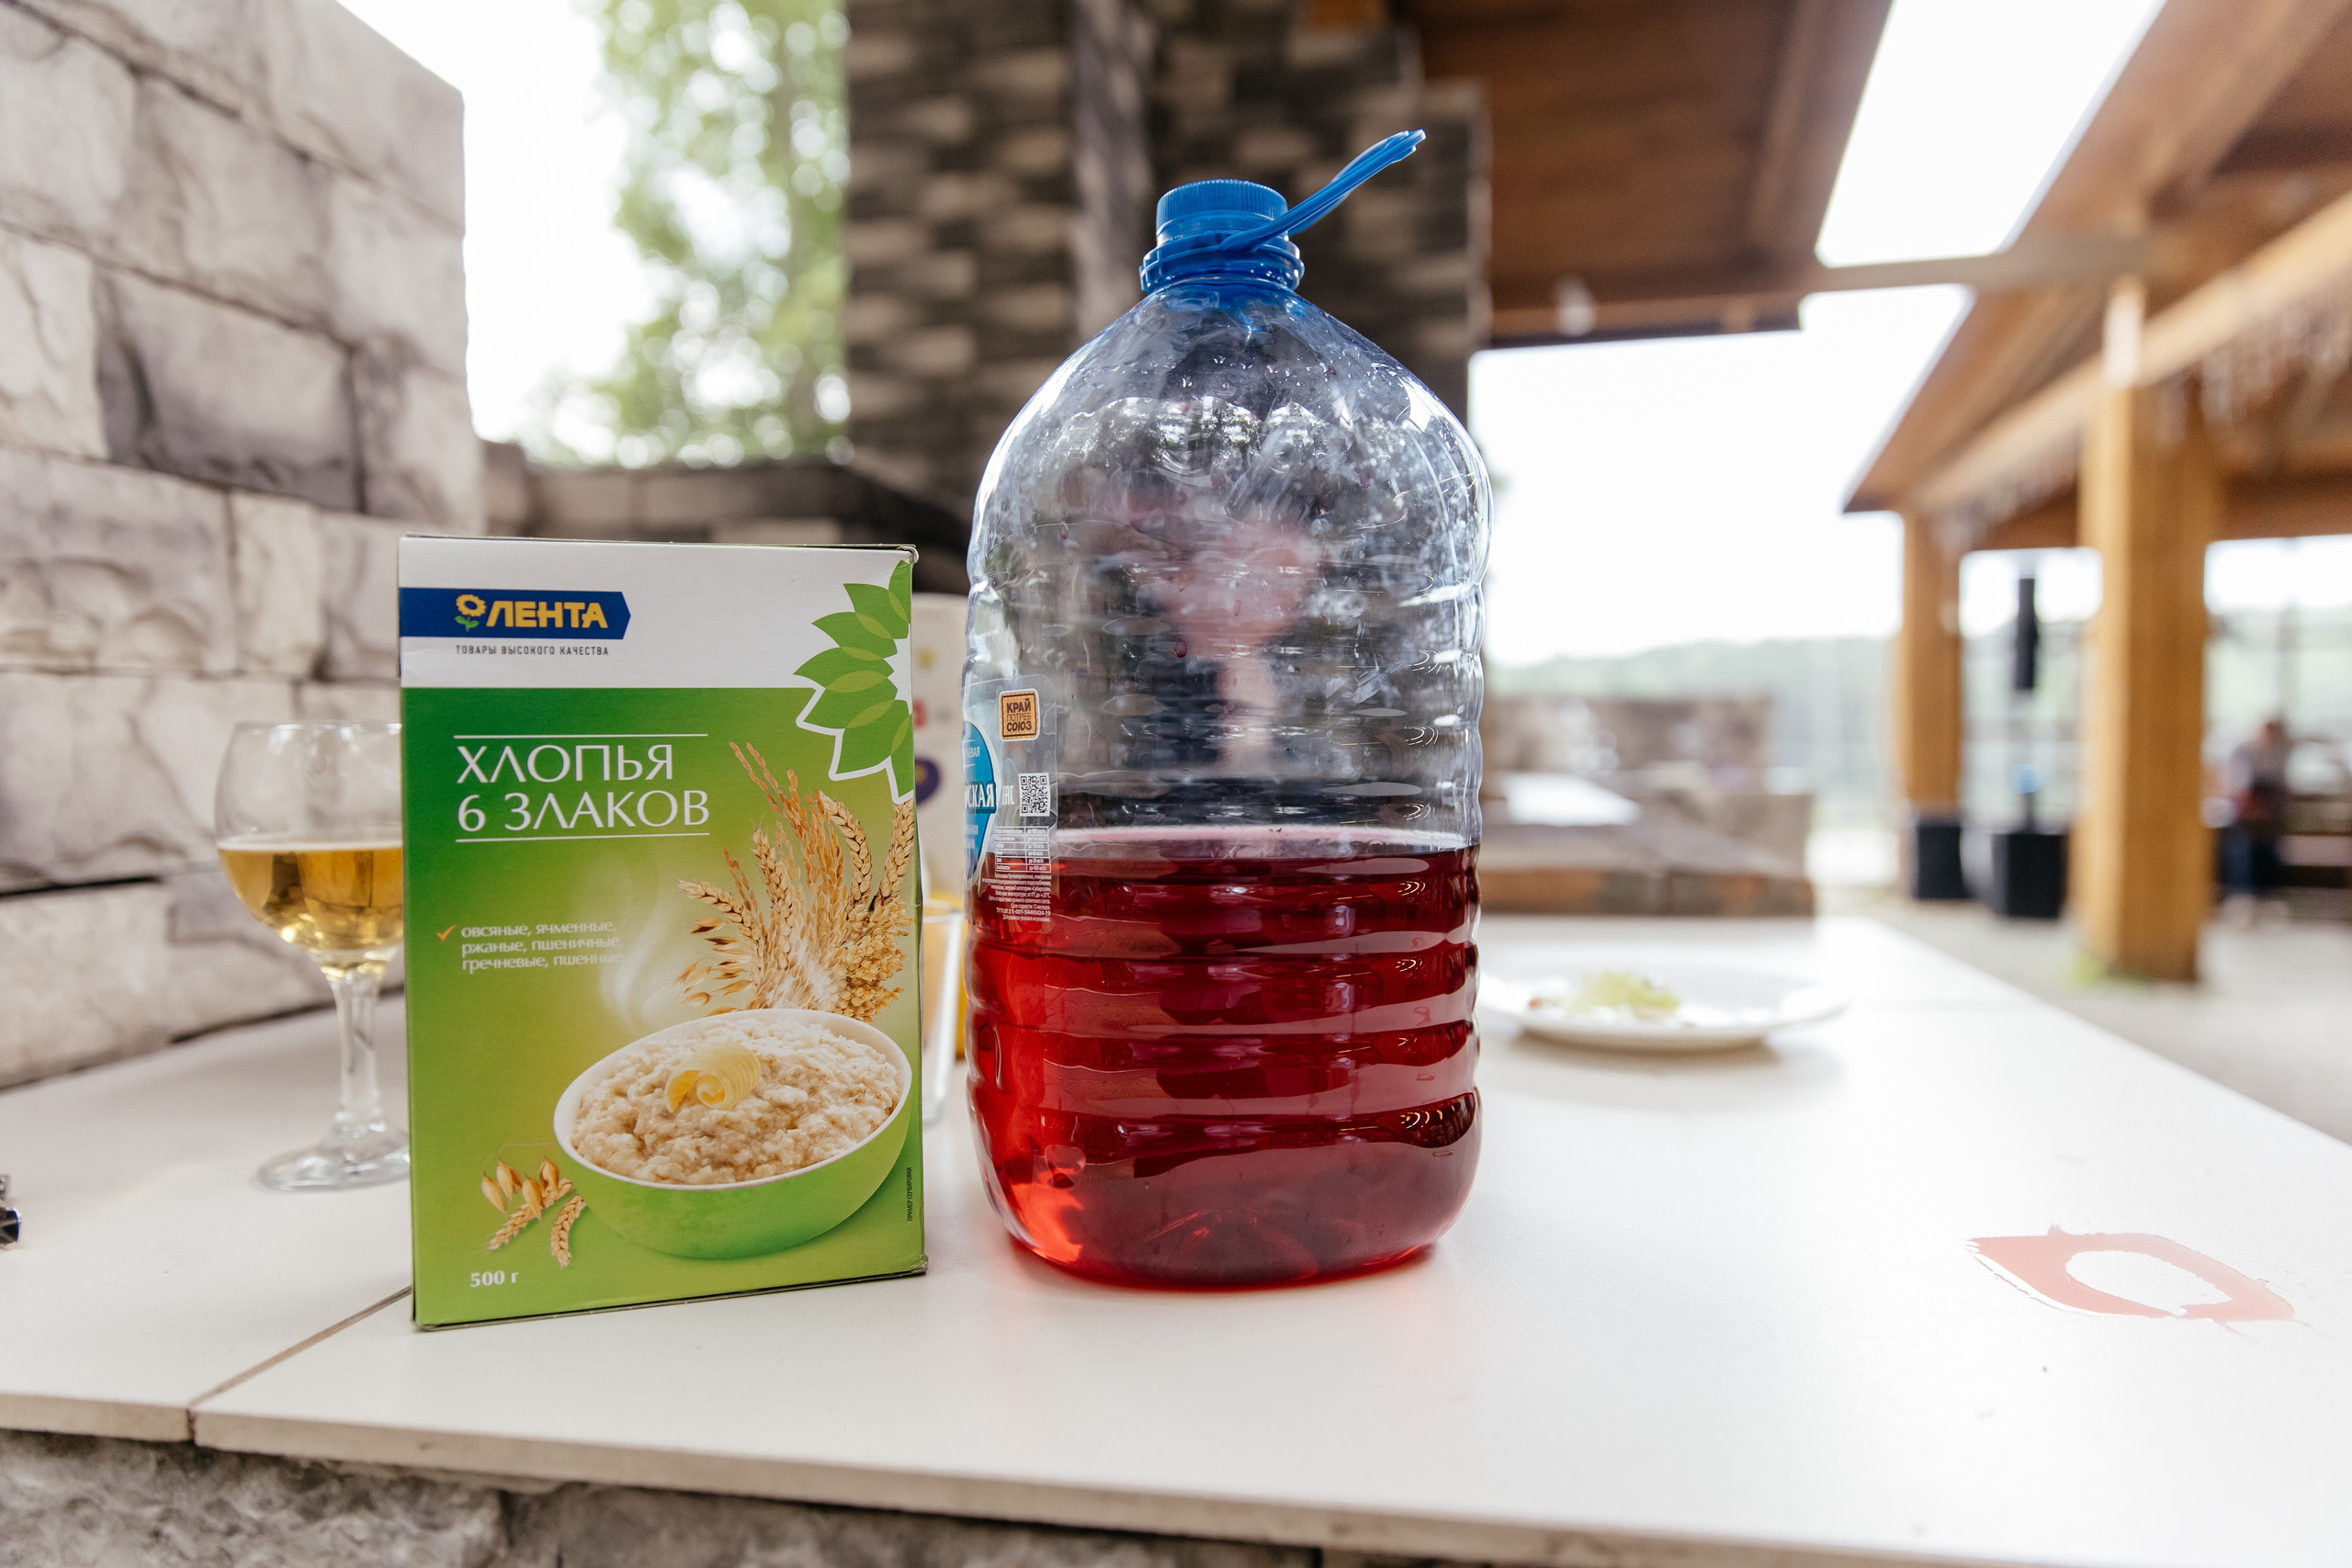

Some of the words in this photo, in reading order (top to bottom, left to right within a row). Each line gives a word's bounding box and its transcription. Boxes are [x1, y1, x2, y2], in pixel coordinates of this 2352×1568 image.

[486, 600, 608, 629] ЛЕНТА
[456, 645, 497, 655] ТОВАРЫ
[501, 645, 555, 655] ВЫСОКОГО
[560, 646, 609, 656] КАЧЕСТВА
[1006, 698, 1031, 713] КРАЙ
[1007, 712, 1031, 722] ПОТРЕБ
[1006, 721, 1032, 732] СОЮЗ
[457, 743, 673, 784] ХЛОПЬЯ
[458, 794, 486, 832] 6
[504, 789, 710, 831] ЗЛАКОВ
[461, 924, 531, 938] овсяные,
[536, 921, 616, 935] ячменные,
[462, 941, 526, 958] ржаные,
[532, 937, 623, 952] пшеничные,
[462, 956, 548, 975] гречневые,
[469, 1270, 505, 1288] 500
[511, 1272, 519, 1284] г
